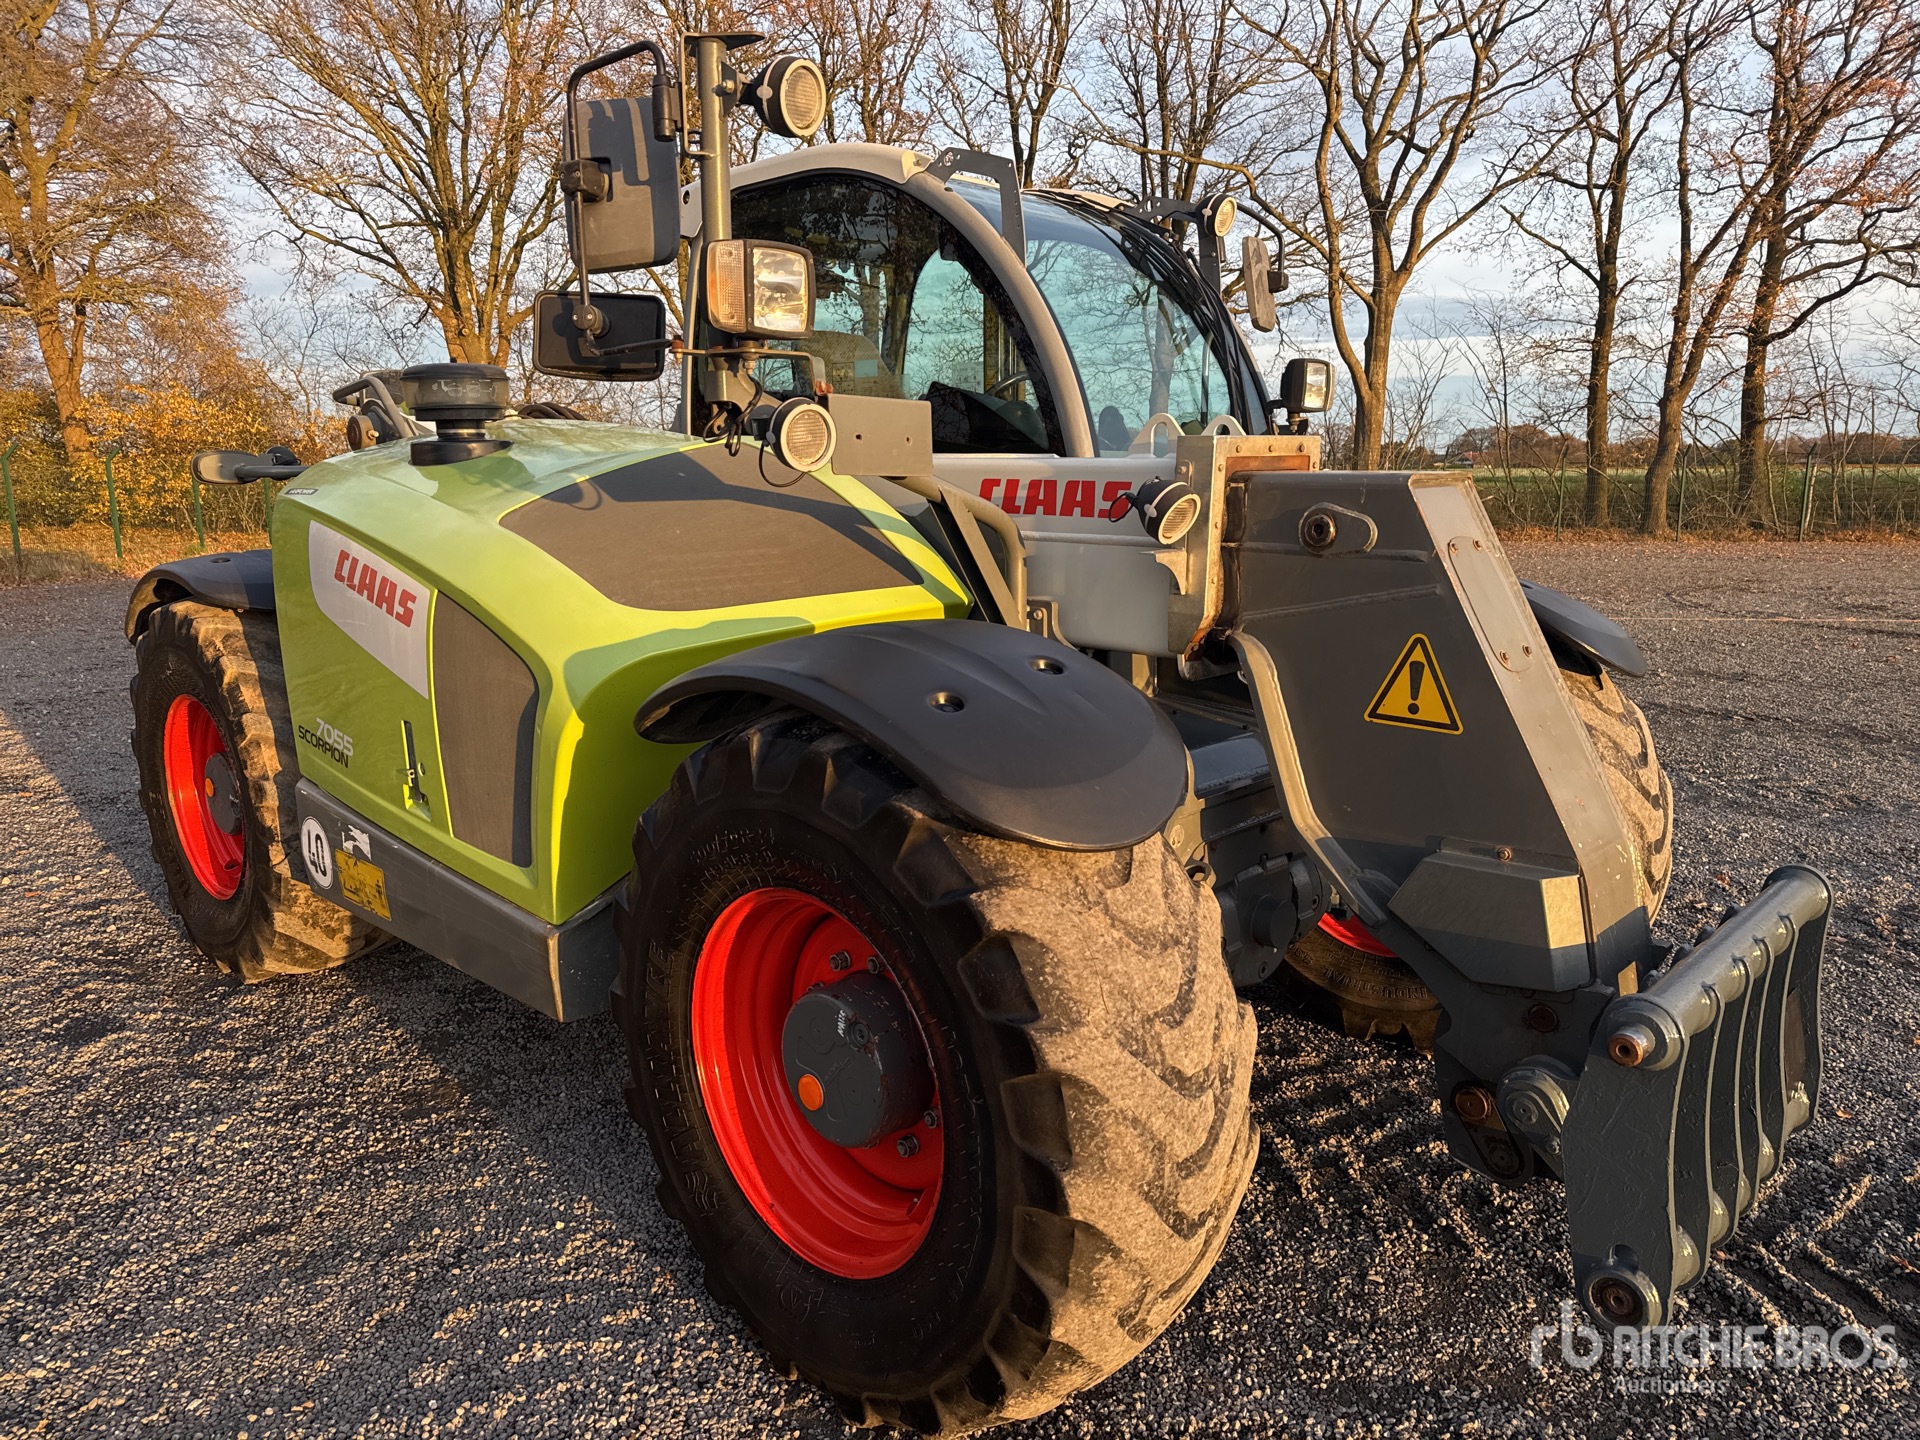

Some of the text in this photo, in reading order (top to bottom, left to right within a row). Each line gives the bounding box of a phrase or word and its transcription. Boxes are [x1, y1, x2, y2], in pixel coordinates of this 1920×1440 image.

[979, 478, 1133, 518] CLAAS
[333, 549, 417, 628] CLAAS
[298, 724, 349, 769] SCORPION
[316, 717, 354, 756] 7055
[307, 829, 327, 877] 40
